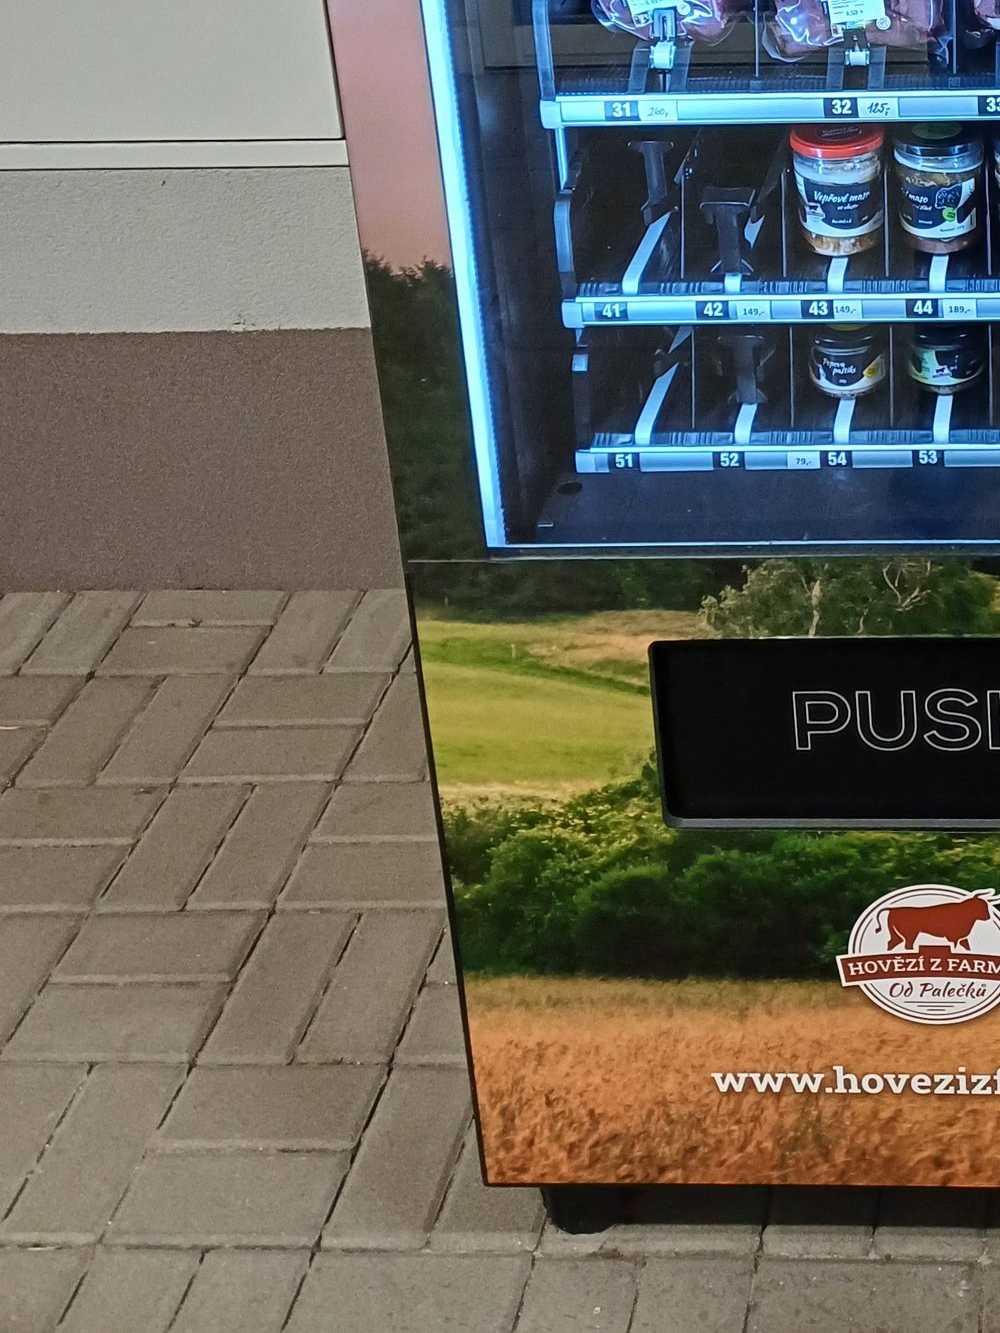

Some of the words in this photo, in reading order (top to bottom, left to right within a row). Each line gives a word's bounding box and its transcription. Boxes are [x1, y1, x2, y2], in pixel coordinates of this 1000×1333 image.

[612, 102, 631, 117] 31
[831, 99, 852, 114] 32
[602, 303, 621, 318] 41
[703, 302, 724, 317] 42
[742, 307, 765, 317] 149,-
[808, 301, 828, 316] 43
[835, 305, 856, 315] 149,-
[913, 300, 933, 315] 44
[949, 305, 971, 315] 189,-
[615, 453, 633, 468] 51
[720, 452, 739, 467] 52
[795, 457, 812, 467] 79,-
[828, 451, 847, 465] 54
[919, 450, 938, 463] 53
[848, 956, 924, 976] HOVĚZÍ
[930, 959, 942, 971] Z
[889, 981, 913, 998] Od
[920, 981, 987, 999] Palečků
